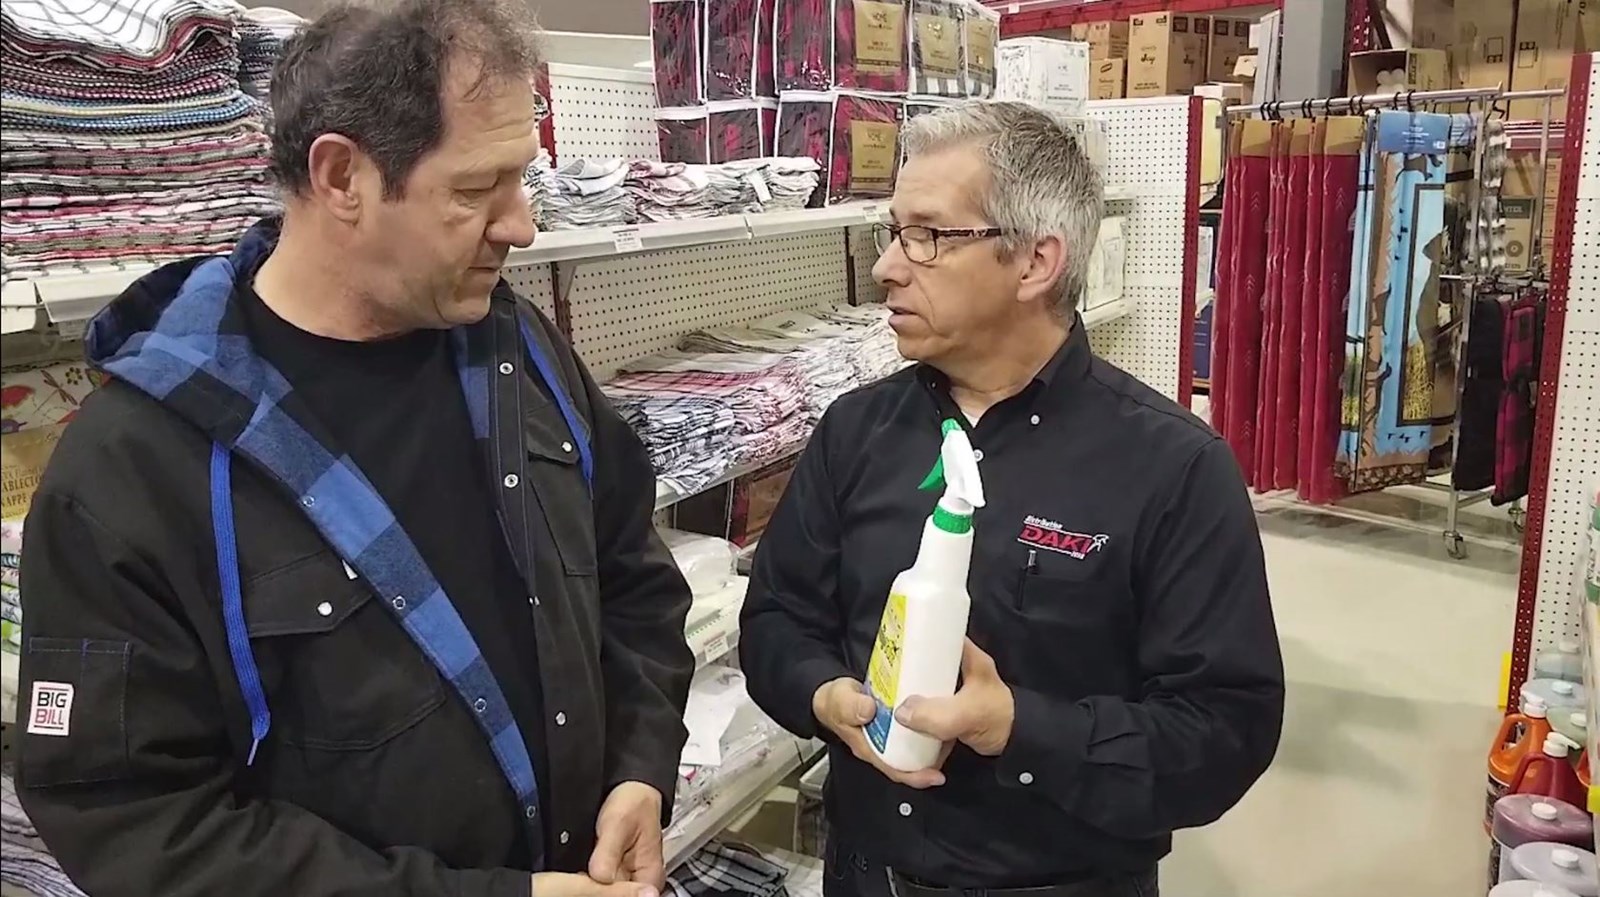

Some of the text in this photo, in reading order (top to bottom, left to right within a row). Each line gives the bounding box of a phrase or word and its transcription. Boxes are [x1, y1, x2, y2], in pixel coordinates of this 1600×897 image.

[1020, 525, 1093, 553] DAKI
[37, 691, 67, 708] BIG
[35, 708, 64, 725] BILL
